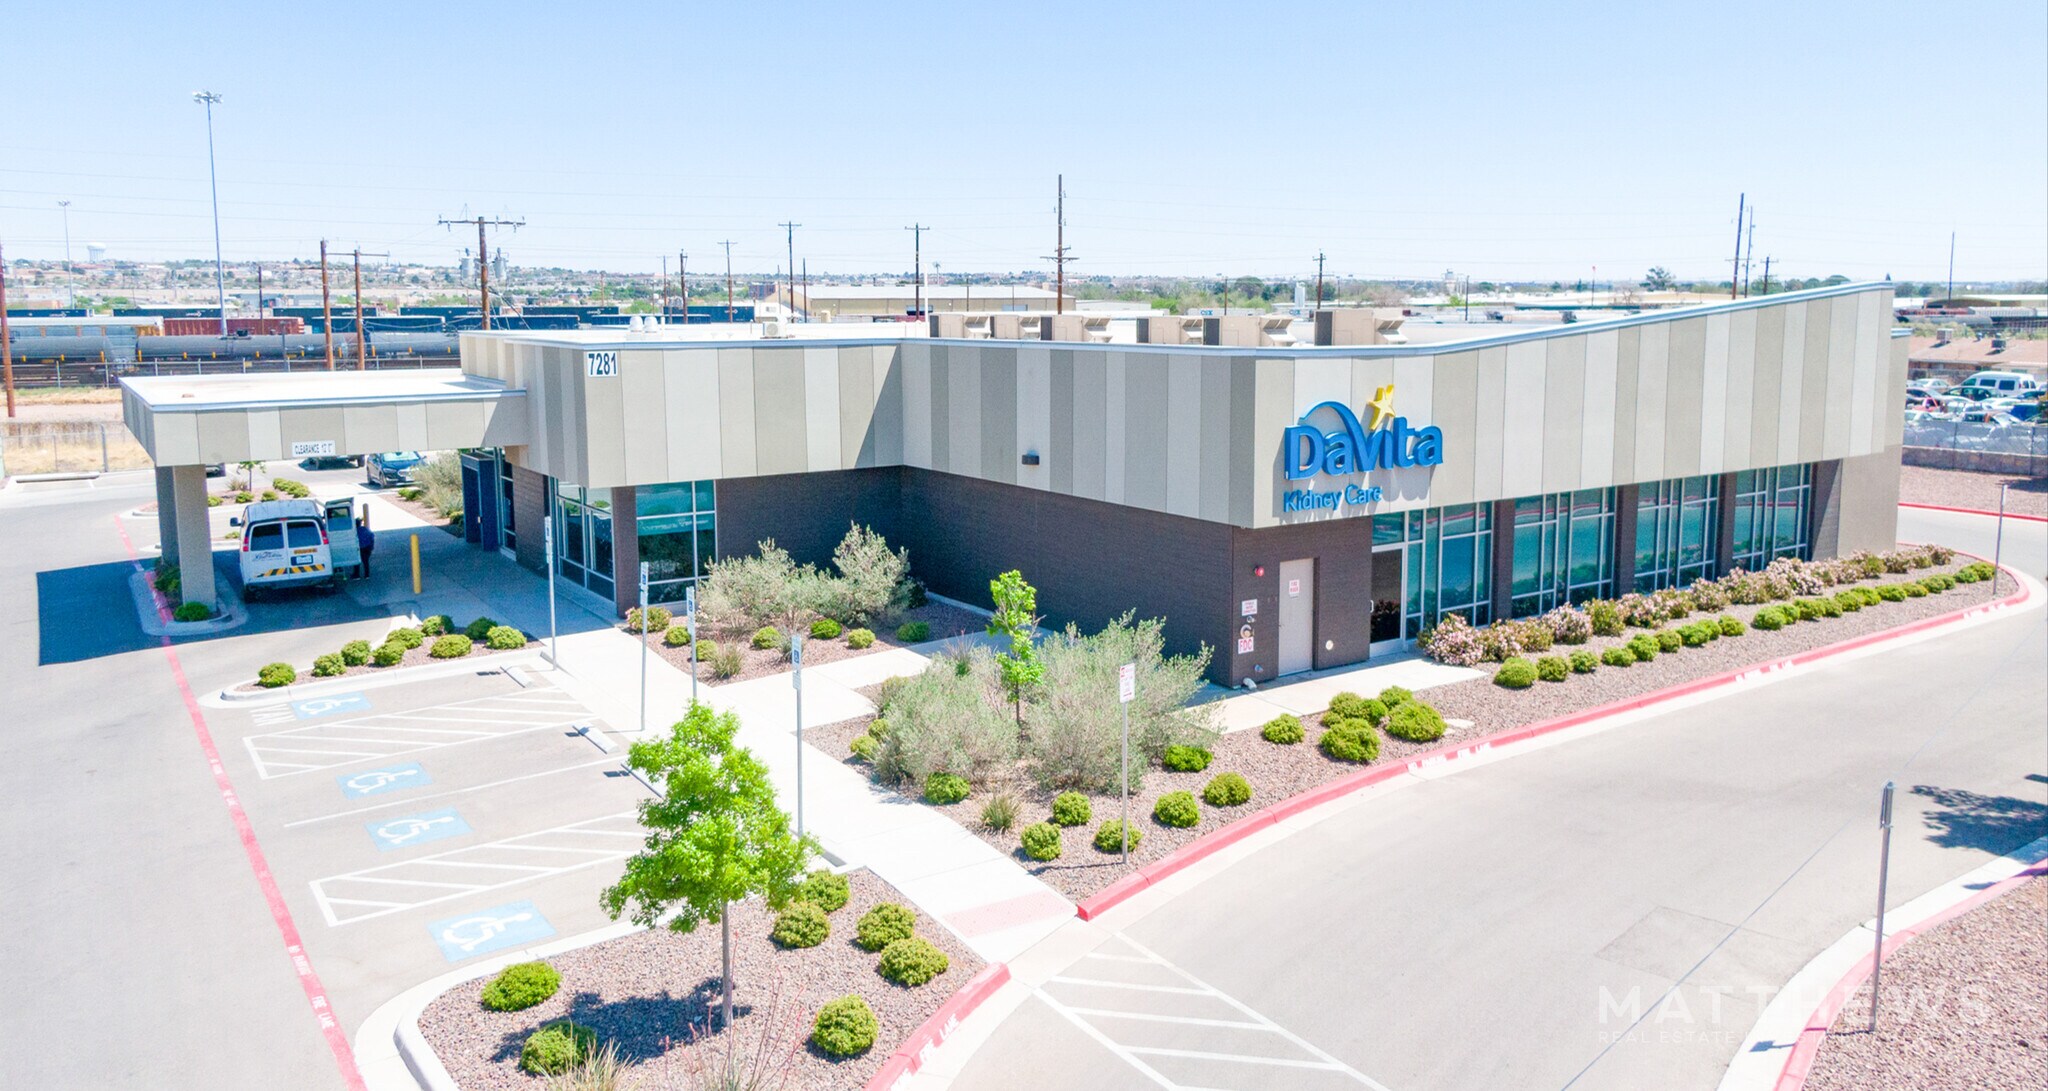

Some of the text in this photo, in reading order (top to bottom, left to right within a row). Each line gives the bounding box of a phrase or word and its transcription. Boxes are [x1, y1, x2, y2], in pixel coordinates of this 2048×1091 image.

[588, 352, 617, 375] 7281
[1284, 401, 1443, 481] DaVita
[1283, 484, 1383, 513] Kidney Care
